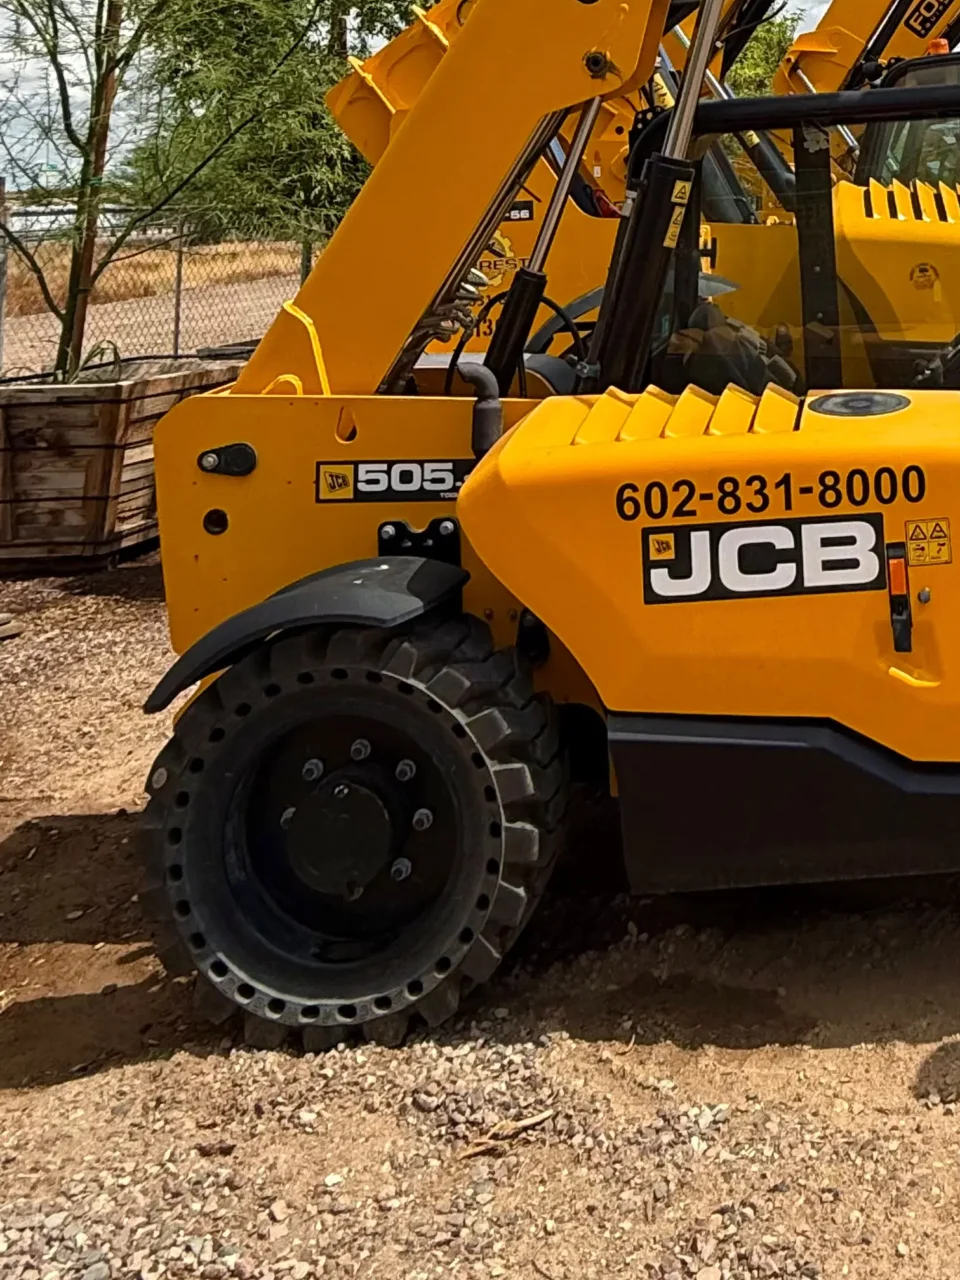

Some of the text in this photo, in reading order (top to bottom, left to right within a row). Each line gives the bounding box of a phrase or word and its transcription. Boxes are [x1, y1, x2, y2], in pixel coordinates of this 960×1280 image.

[479, 257, 528, 270] REST
[327, 462, 469, 492] JCB 505-
[615, 465, 926, 521] 602-831-8000
[650, 521, 880, 597] JCB
